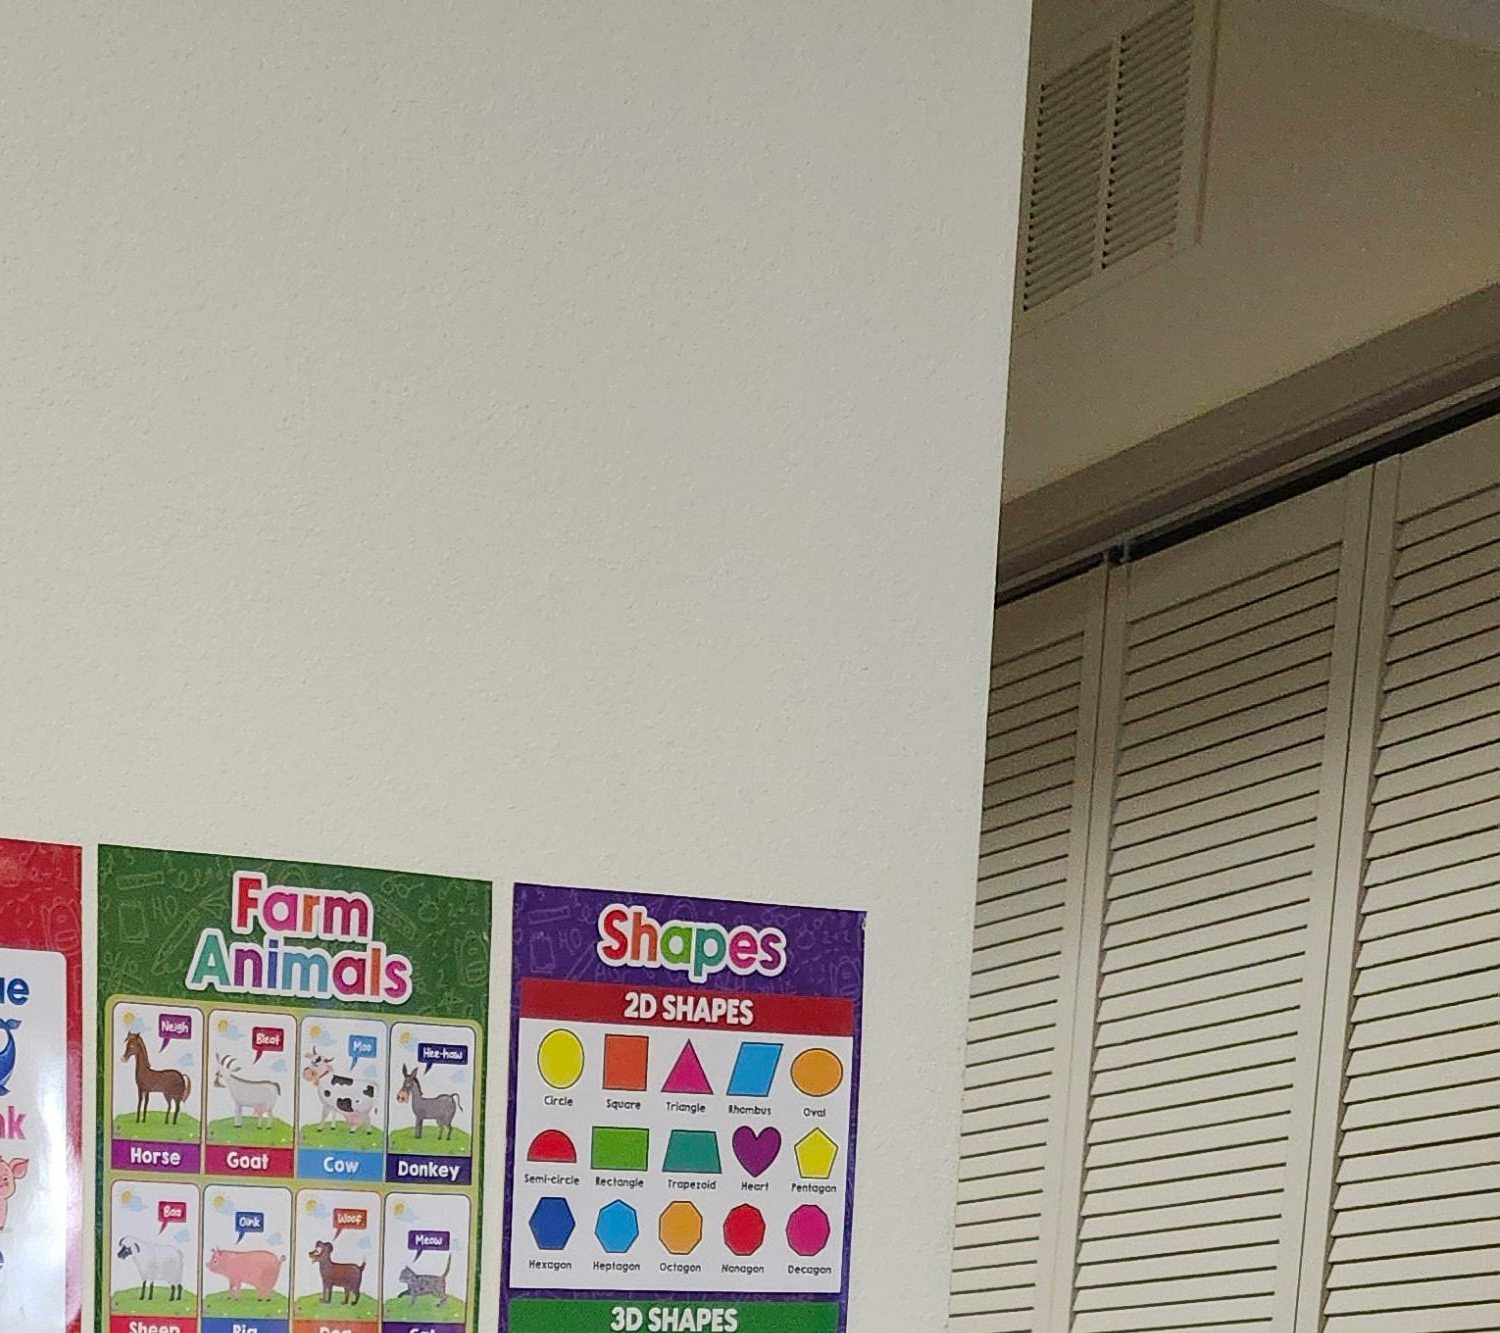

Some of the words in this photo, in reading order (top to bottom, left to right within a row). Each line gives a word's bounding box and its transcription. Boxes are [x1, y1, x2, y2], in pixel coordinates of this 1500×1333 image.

[232, 871, 372, 942] Farm
[598, 903, 787, 984] Shapes
[186, 928, 412, 1003] Animals
[624, 992, 657, 1019] 2D
[662, 994, 753, 1025] SHAPES
[161, 1020, 190, 1035] Neigh
[353, 1041, 372, 1054] Moo
[543, 1094, 574, 1107] Circle
[606, 1098, 642, 1111] Square
[665, 1101, 707, 1115] Triangle
[727, 1104, 772, 1116] Rhombus
[802, 1107, 827, 1118] Oval
[130, 1147, 181, 1165] Horse
[226, 1151, 269, 1169] Goat
[323, 1156, 359, 1173] Cow
[398, 1160, 460, 1181] Donkey
[523, 1173, 581, 1186] Semi-circle
[595, 1175, 644, 1190] Rectangle
[667, 1178, 717, 1191] Trapezoid
[740, 1181, 770, 1192] Heart
[790, 1182, 837, 1195] Pentagon
[163, 1206, 183, 1218] Baa
[239, 1217, 261, 1229] Oink
[415, 1235, 443, 1247] Meow
[528, 1259, 573, 1272] Hexagon
[592, 1260, 641, 1274] Heptagon
[659, 1262, 702, 1275] Octagon
[720, 1263, 765, 1276] Nonagon
[787, 1264, 832, 1277] Decagon
[610, 1306, 643, 1331] 3D
[648, 1307, 738, 1332] SHAPES
